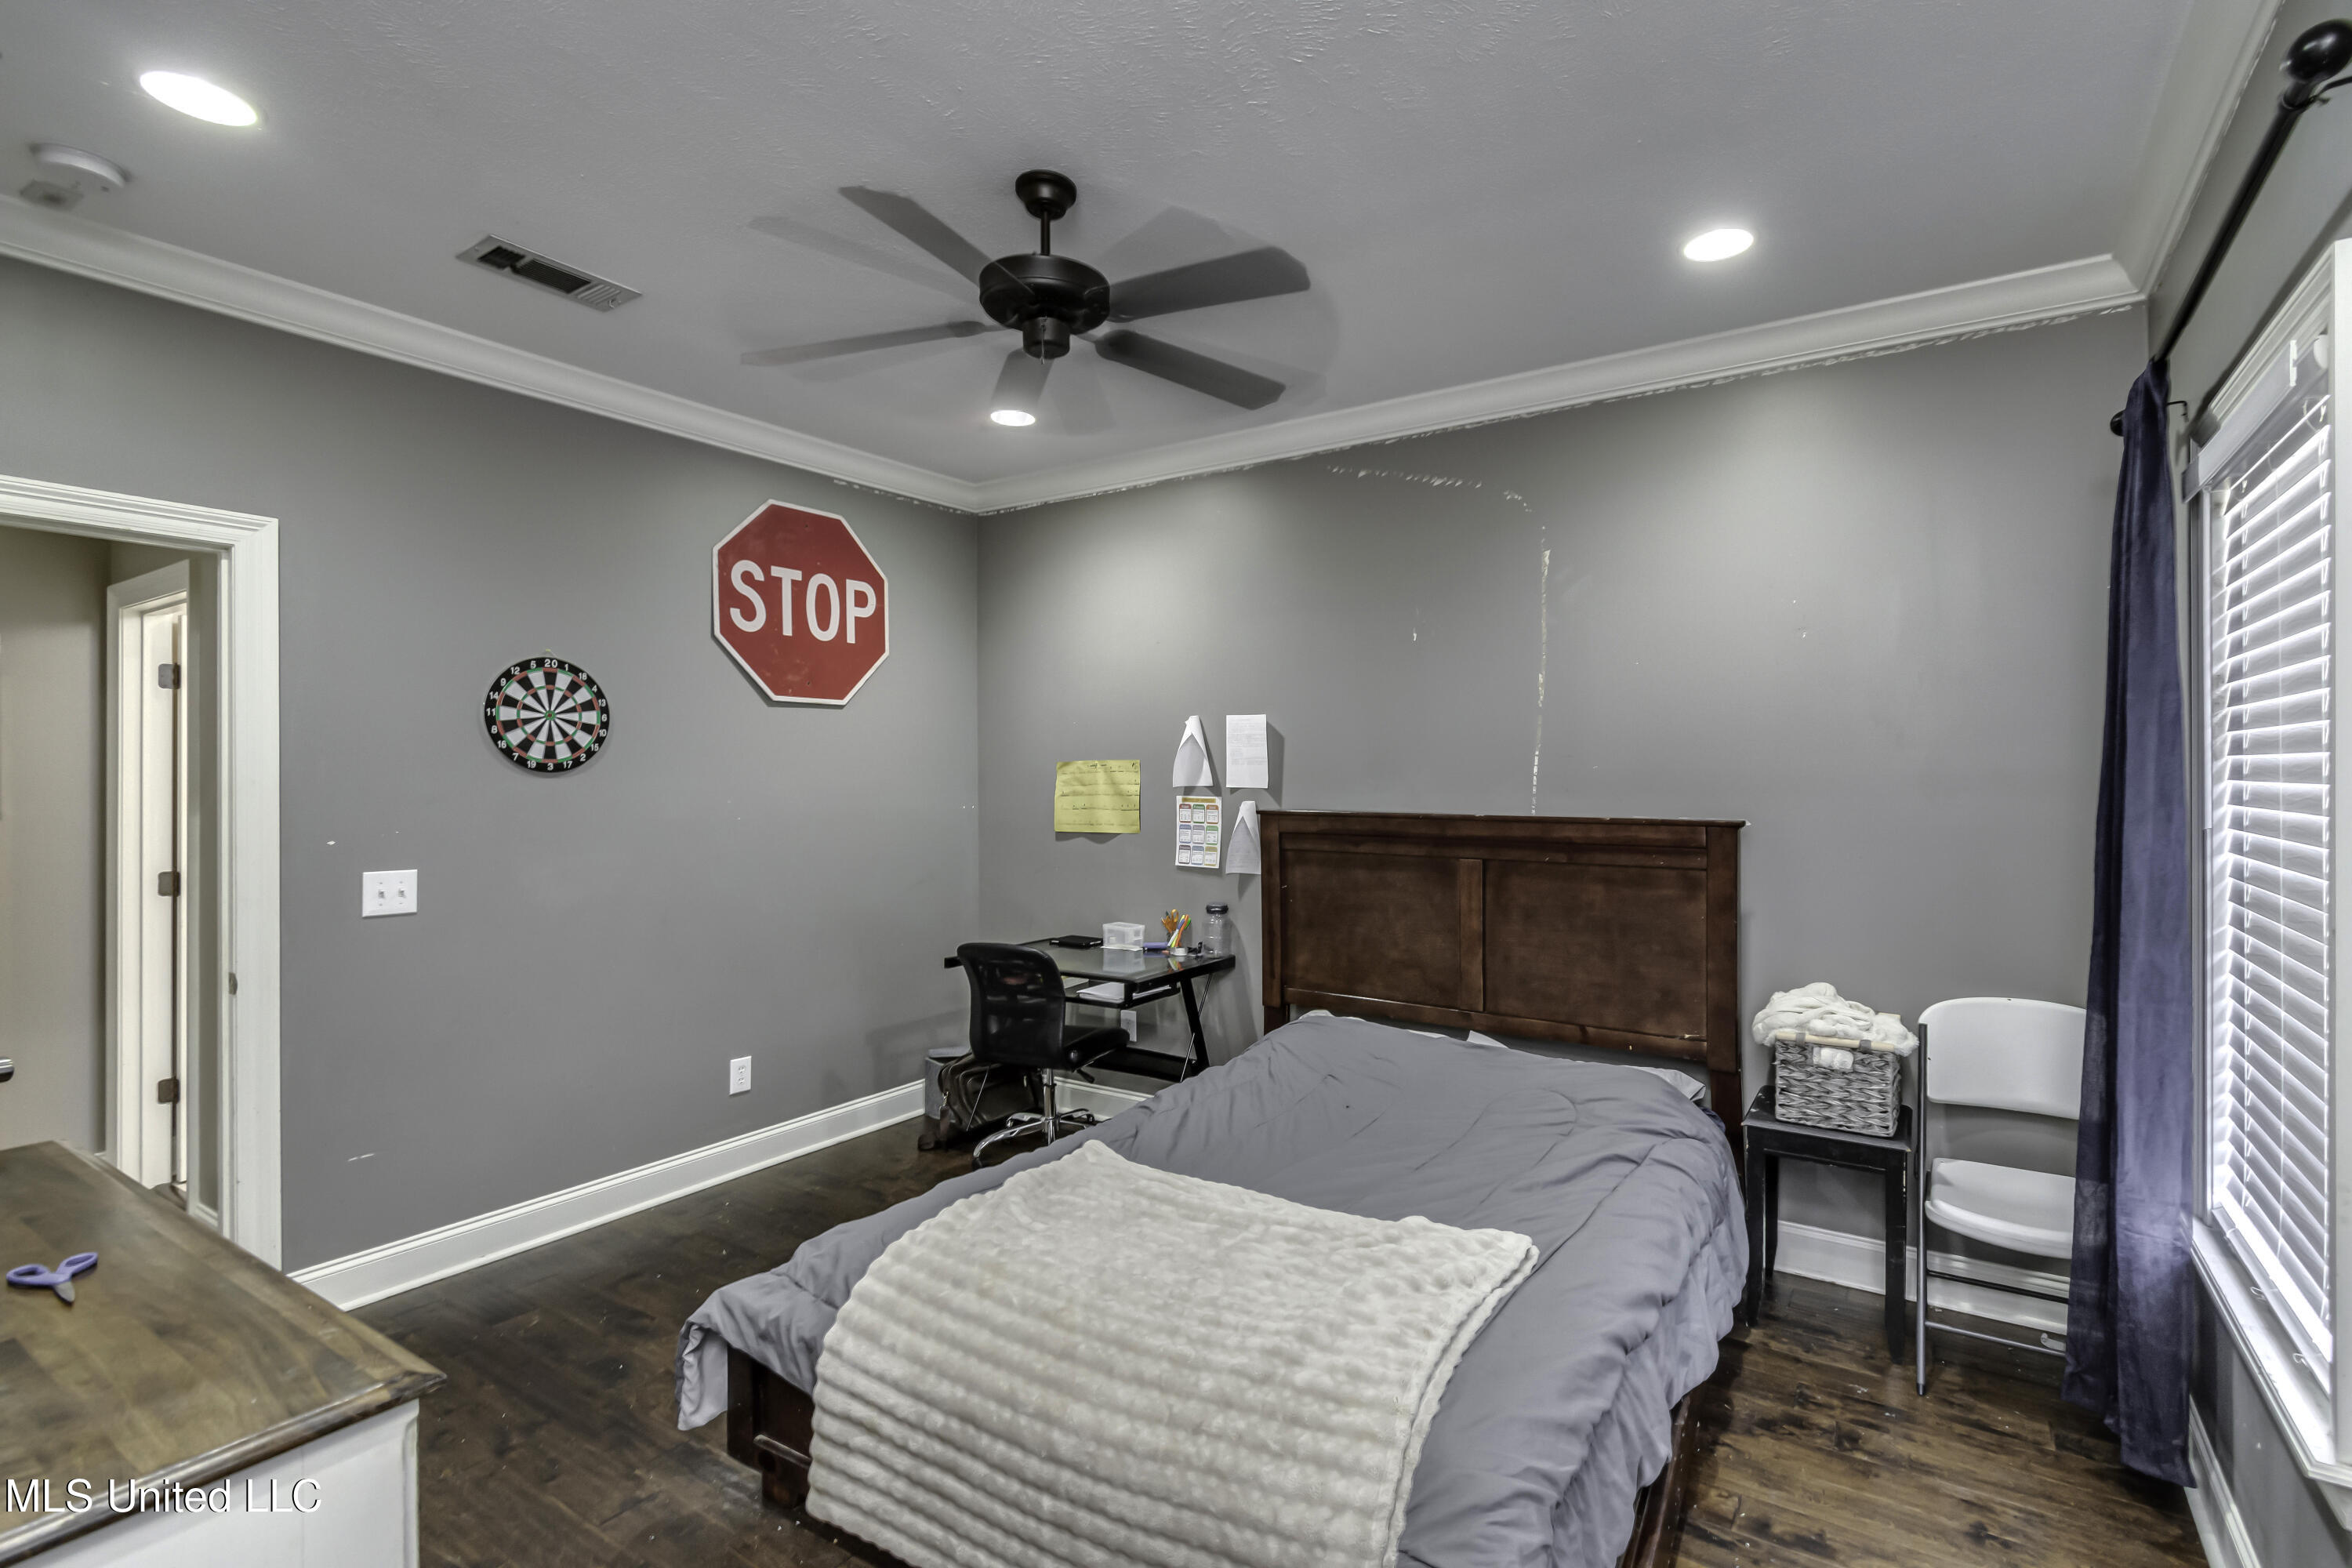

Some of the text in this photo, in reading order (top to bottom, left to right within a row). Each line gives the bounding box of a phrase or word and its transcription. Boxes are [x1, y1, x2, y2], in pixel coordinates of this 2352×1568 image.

[730, 560, 877, 644] STOP
[544, 658, 558, 668] 20
[500, 678, 506, 686] 9
[491, 725, 498, 733] 8
[513, 753, 519, 761] 7
